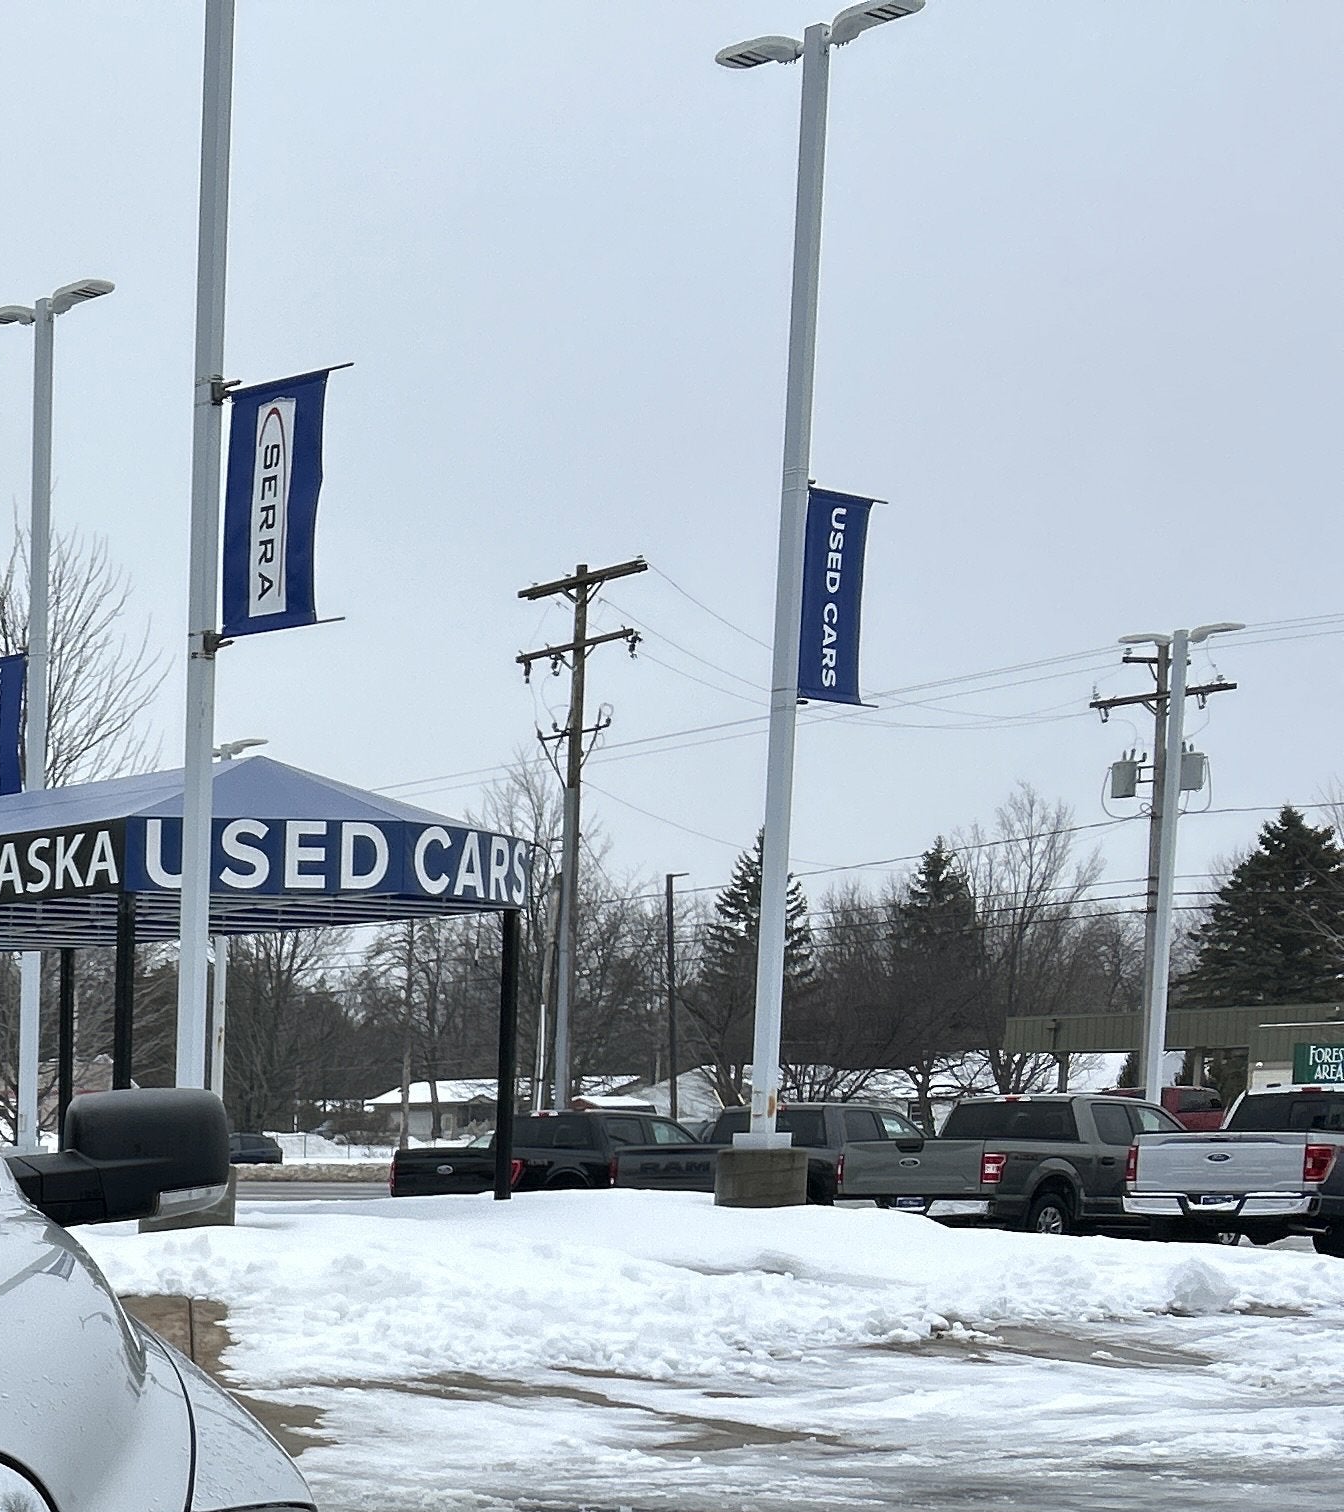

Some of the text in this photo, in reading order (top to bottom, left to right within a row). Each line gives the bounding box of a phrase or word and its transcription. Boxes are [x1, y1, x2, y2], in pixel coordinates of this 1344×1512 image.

[257, 444, 280, 601] SERRA
[820, 507, 847, 688] USED CARS
[414, 825, 527, 906] CARS
